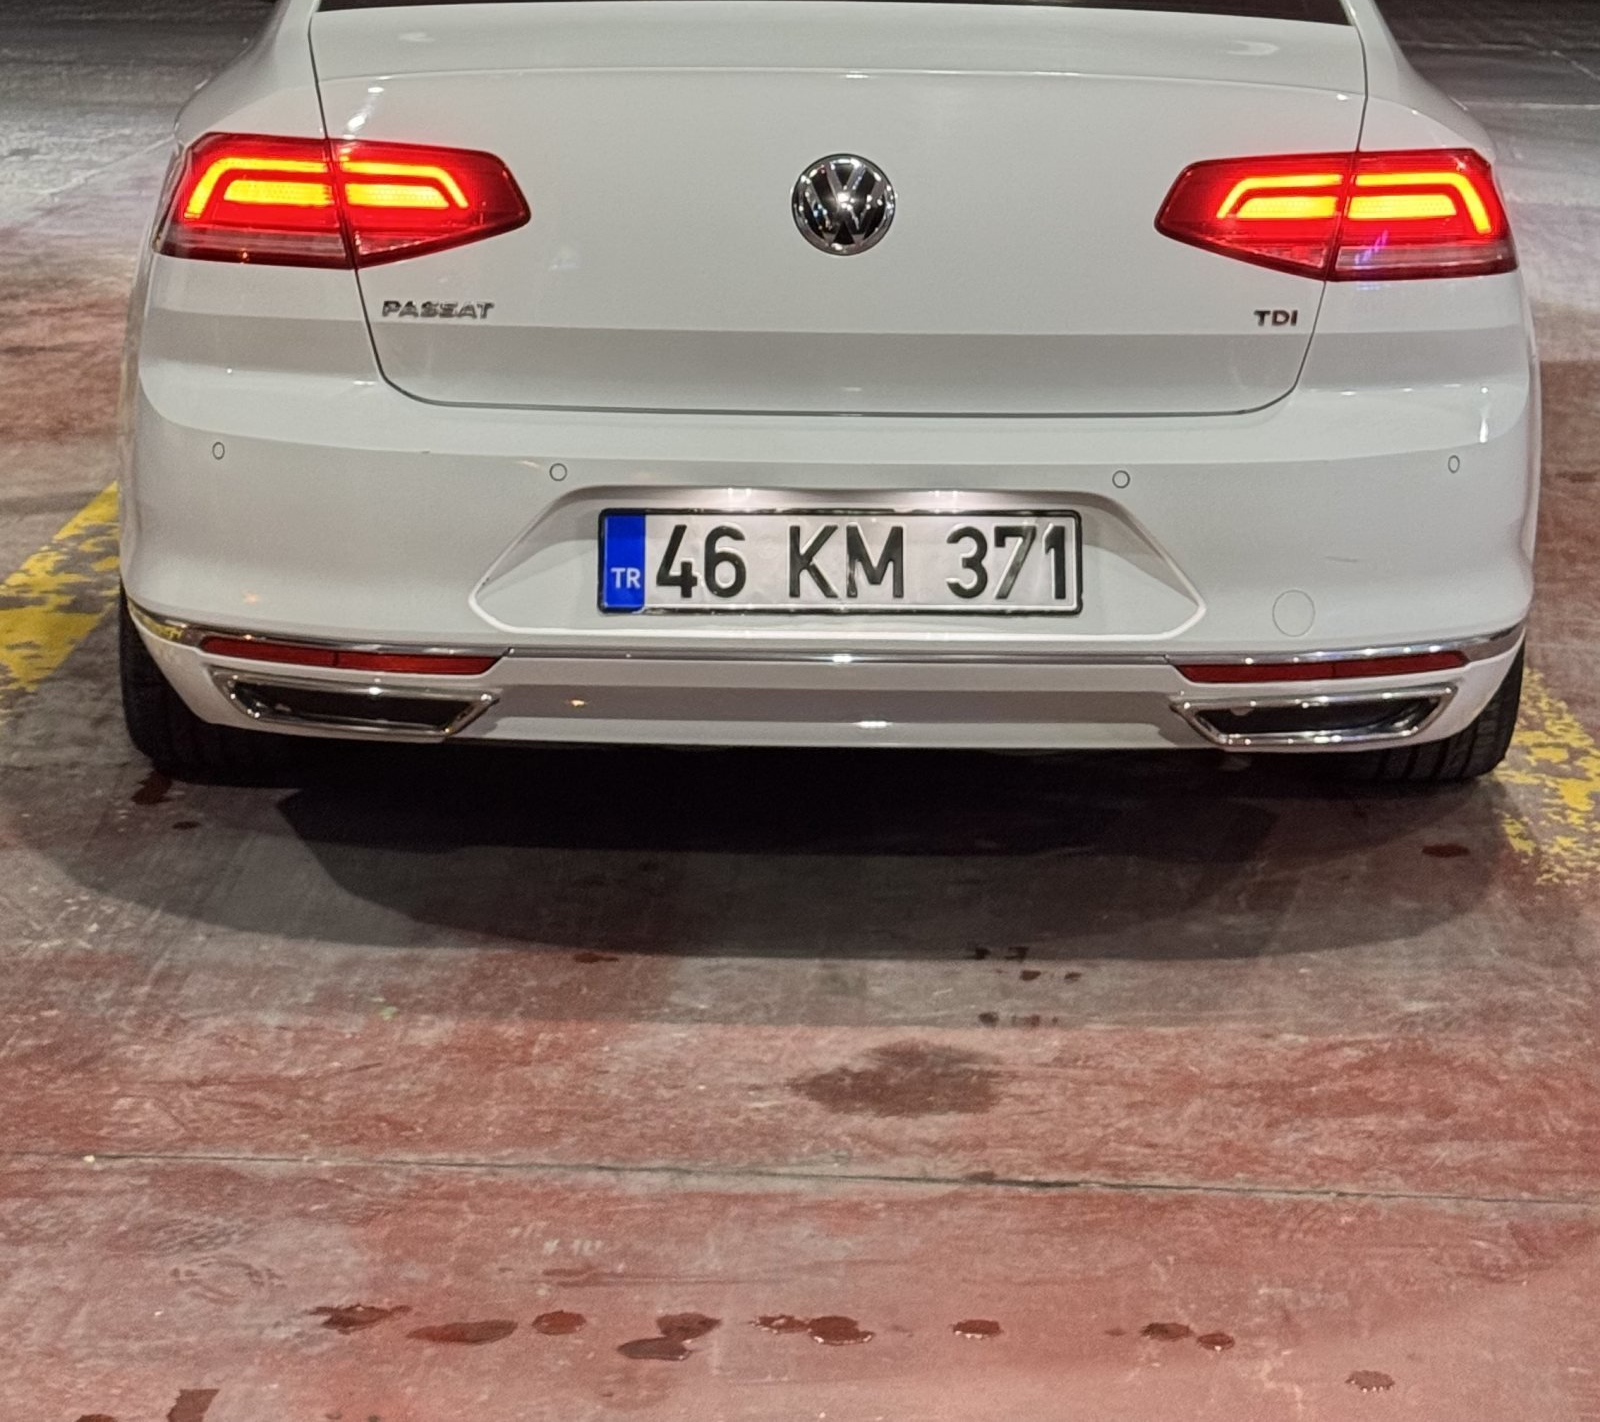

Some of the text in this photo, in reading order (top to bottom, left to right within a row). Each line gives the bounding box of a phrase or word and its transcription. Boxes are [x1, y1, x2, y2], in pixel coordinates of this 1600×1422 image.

[382, 300, 495, 319] PASSAT
[1253, 309, 1299, 327] TDI
[610, 523, 1067, 599] TR 46 KM 371
